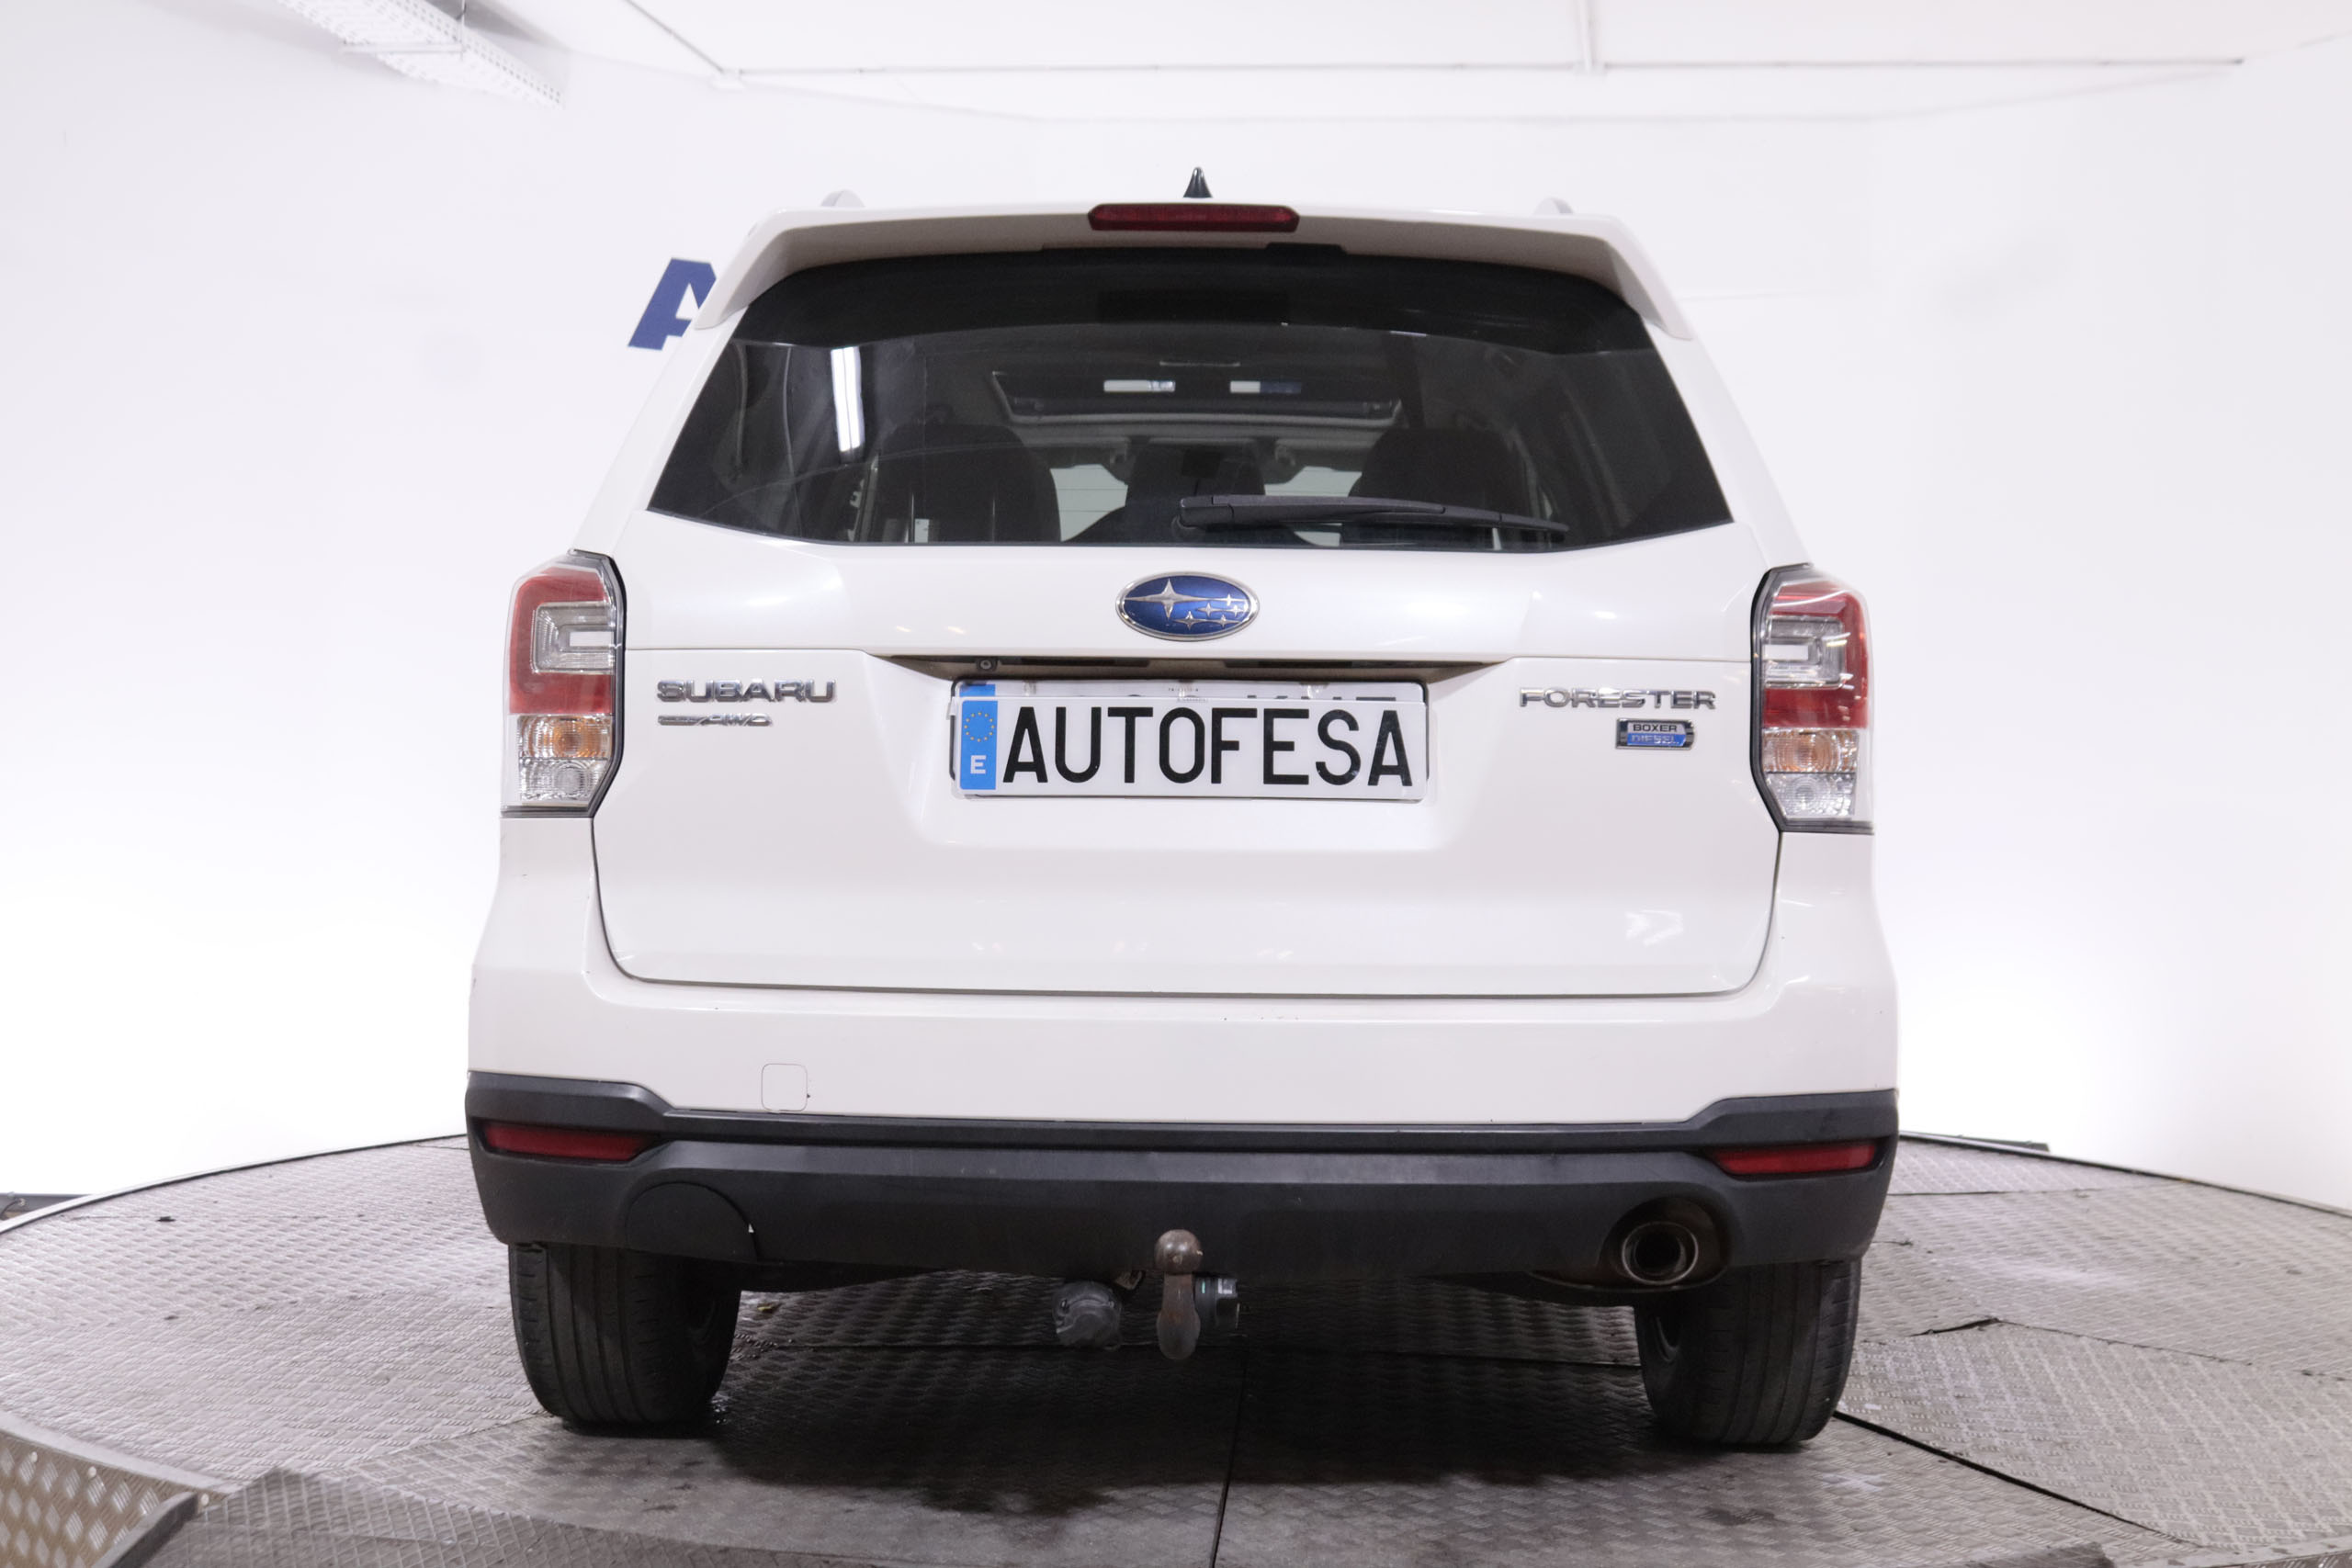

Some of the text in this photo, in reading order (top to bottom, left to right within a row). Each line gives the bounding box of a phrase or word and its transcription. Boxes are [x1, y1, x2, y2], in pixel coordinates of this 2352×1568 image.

[657, 679, 835, 703] SUBARU
[1520, 687, 1716, 710] FORESTER
[1633, 723, 1678, 733] BOXER
[970, 706, 1412, 786] E AUTOFESA
